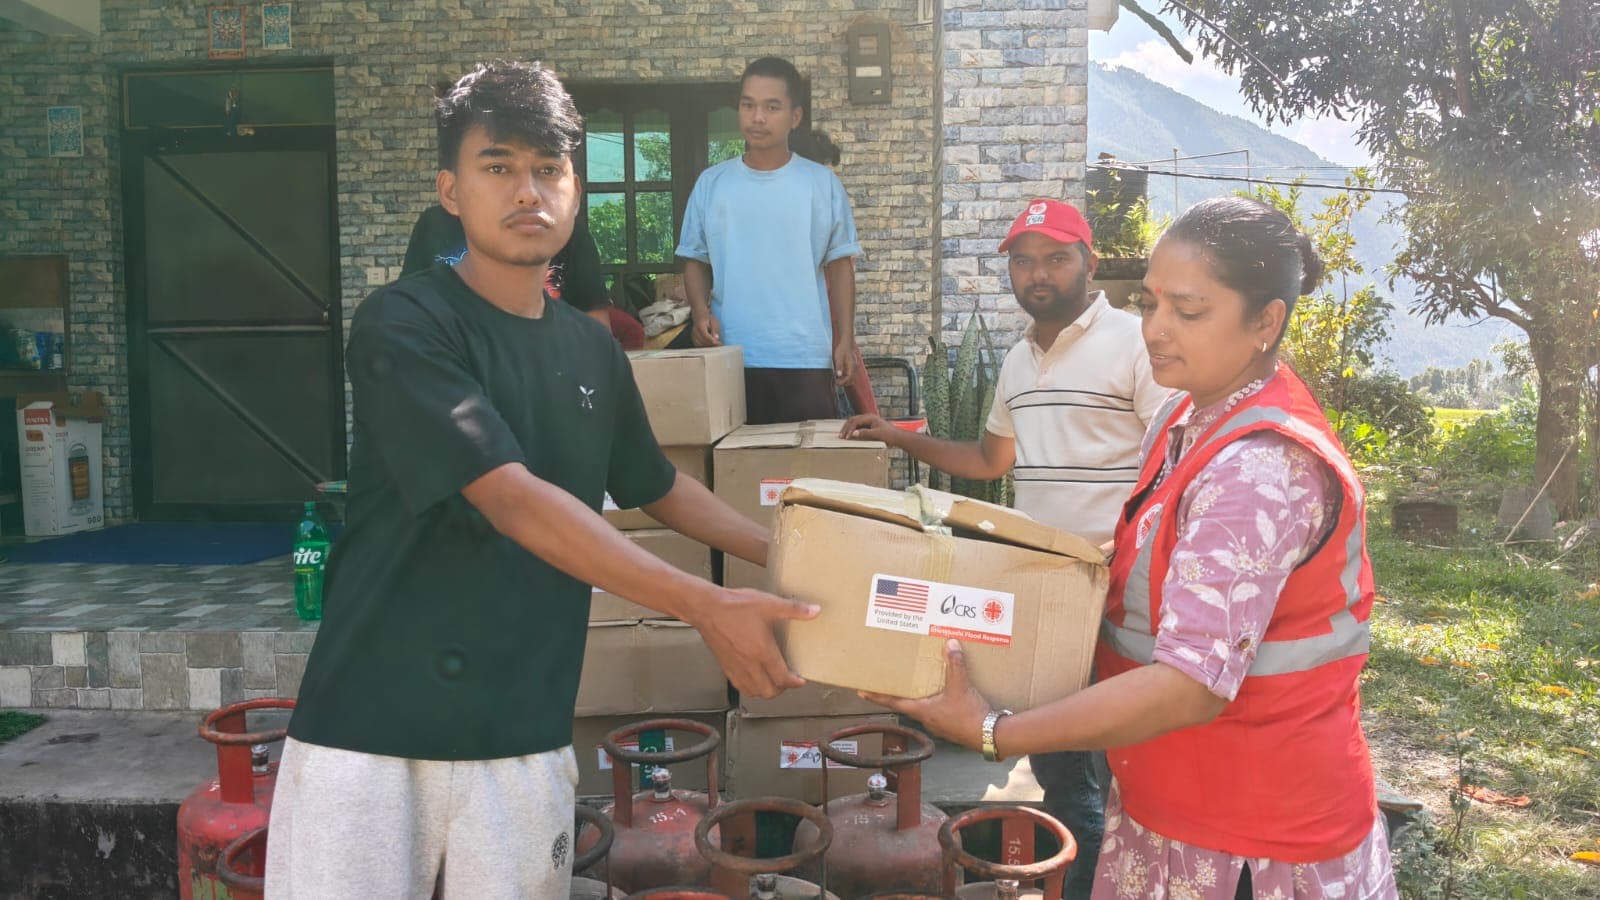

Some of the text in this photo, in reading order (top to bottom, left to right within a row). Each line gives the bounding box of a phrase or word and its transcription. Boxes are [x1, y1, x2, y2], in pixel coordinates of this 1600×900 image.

[874, 608, 924, 622] Provided by the
[876, 618, 919, 629] United States
[964, 631, 982, 640] Flood
